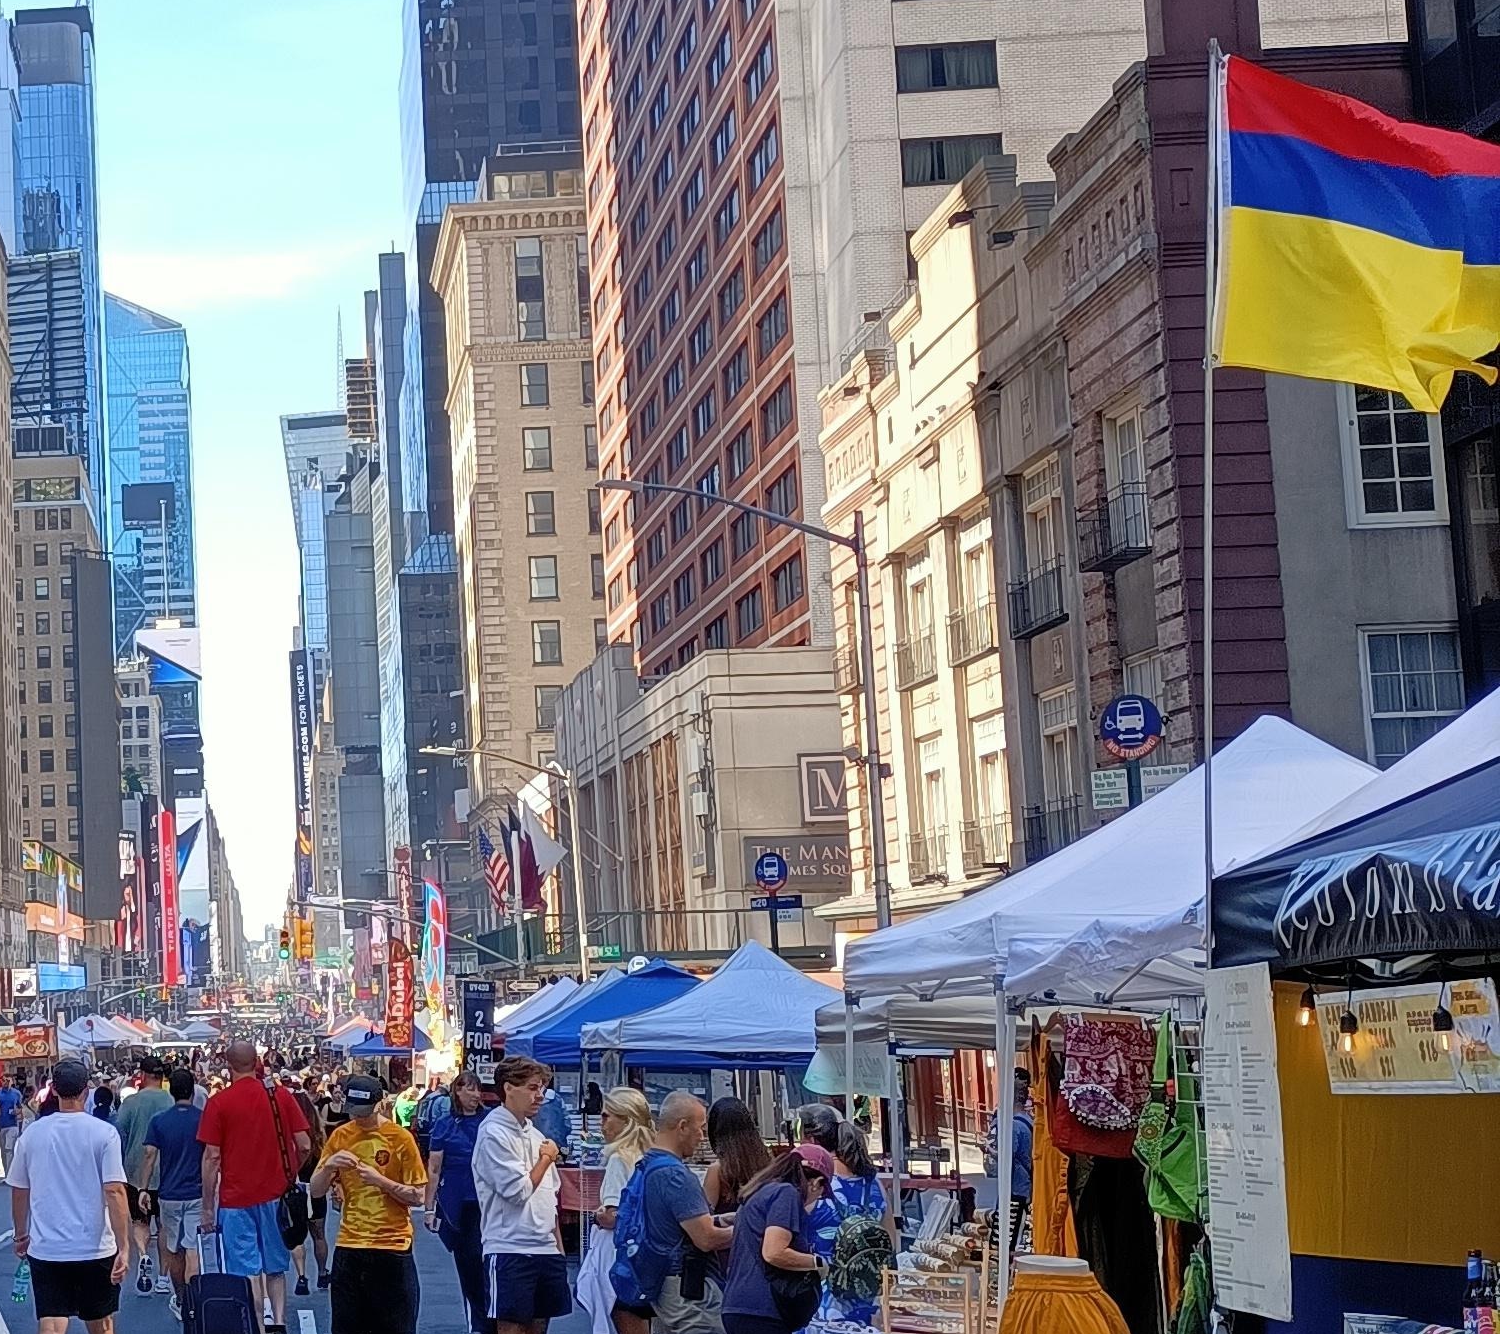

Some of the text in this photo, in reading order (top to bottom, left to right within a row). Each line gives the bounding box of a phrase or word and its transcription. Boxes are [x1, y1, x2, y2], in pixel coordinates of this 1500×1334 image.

[296, 664, 305, 703] TICKETS
[299, 705, 307, 726] FOR
[1106, 738, 1156, 758] NO STANDING
[811, 768, 848, 810] M
[474, 1011, 484, 1027] 2
[466, 1032, 491, 1050] FOR
